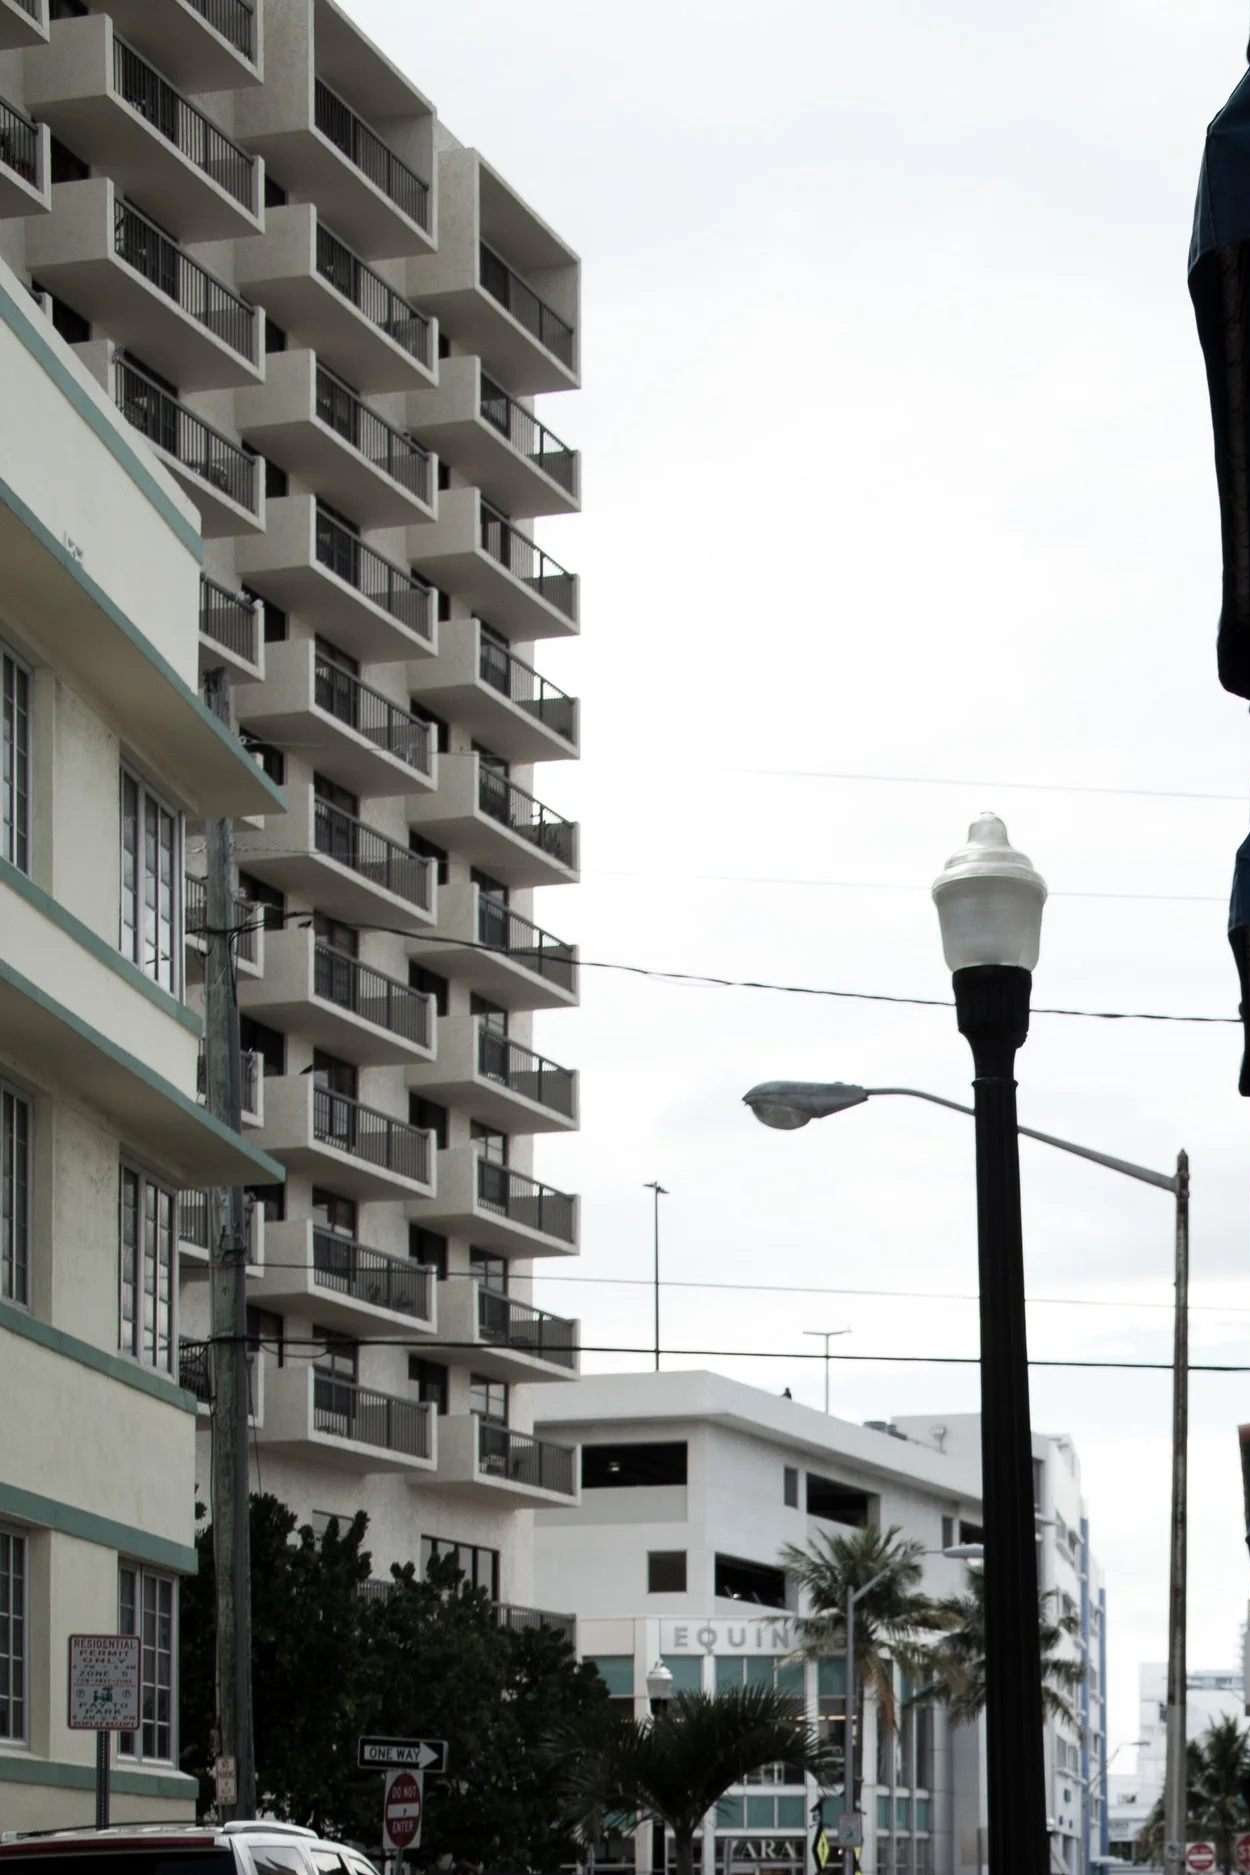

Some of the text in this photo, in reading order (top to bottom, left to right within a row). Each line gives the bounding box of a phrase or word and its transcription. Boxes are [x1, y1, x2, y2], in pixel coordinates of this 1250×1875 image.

[74, 1639, 136, 1649] RESIDENTIAL
[80, 1670, 109, 1678] ZONE
[369, 1747, 421, 1763] ONE WAY
[392, 1786, 417, 1799] DO NOT
[392, 1820, 415, 1834] ENTER
